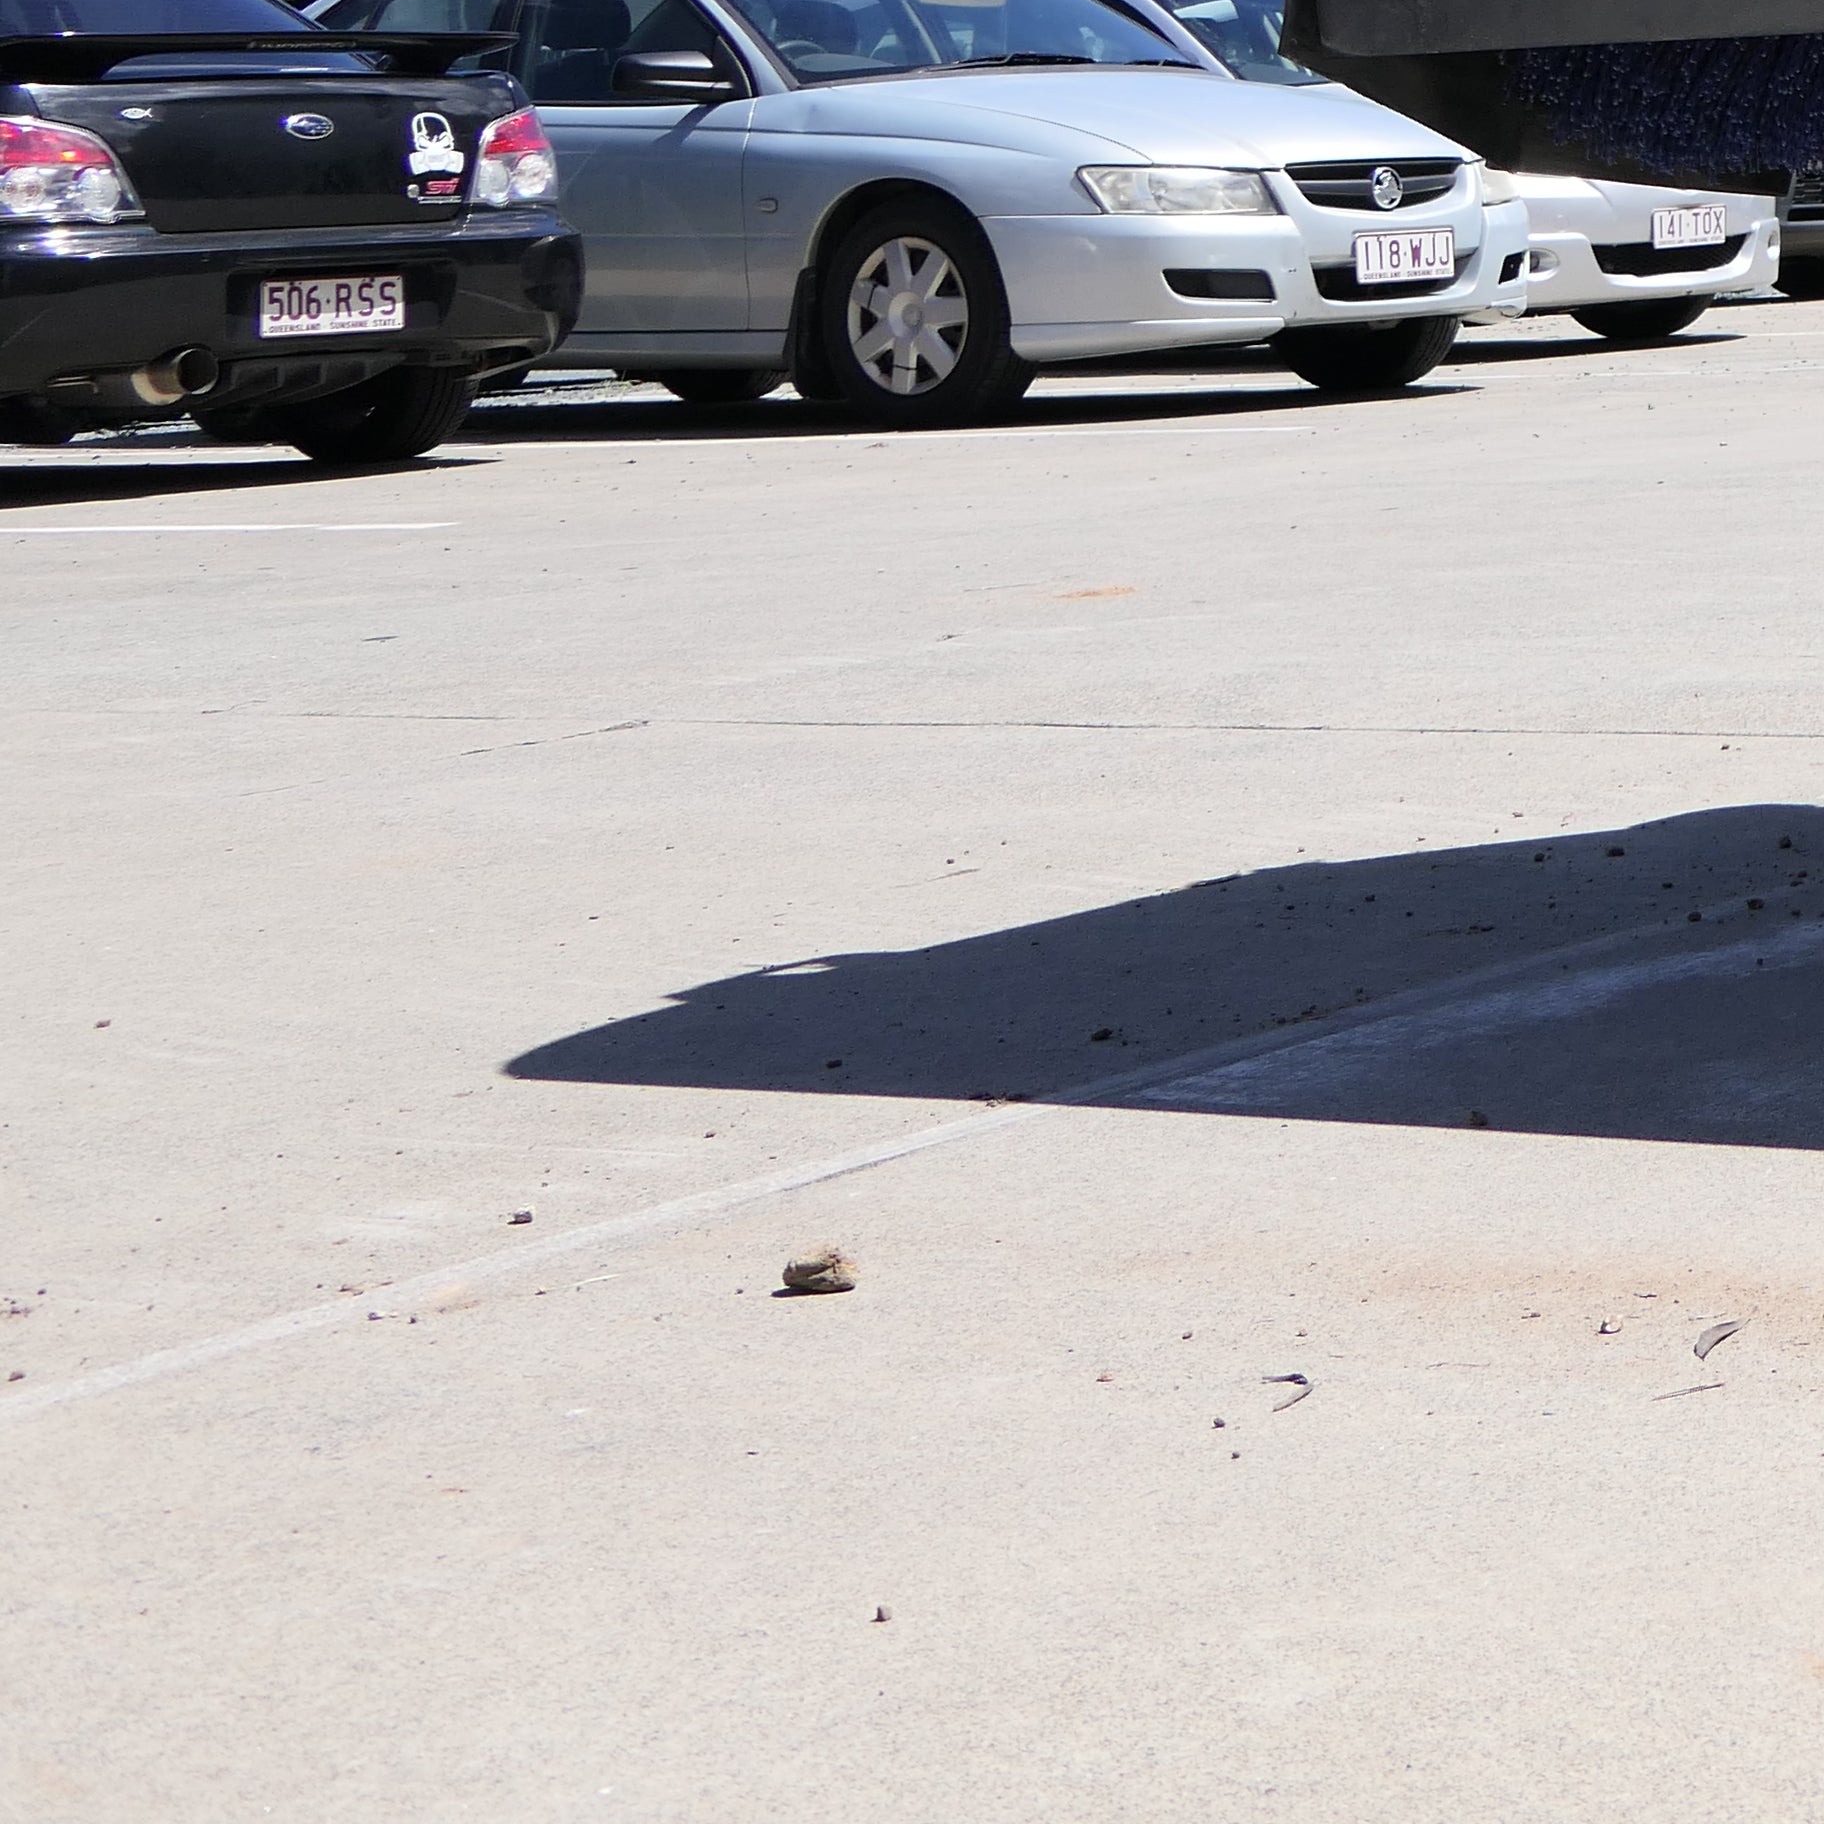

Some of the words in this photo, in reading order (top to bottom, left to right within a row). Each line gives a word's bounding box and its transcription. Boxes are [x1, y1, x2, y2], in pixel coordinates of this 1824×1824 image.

[268, 323, 321, 334] QUEENSLAND
[329, 320, 369, 330] SUNSHINE
[373, 318, 396, 327] STATE
